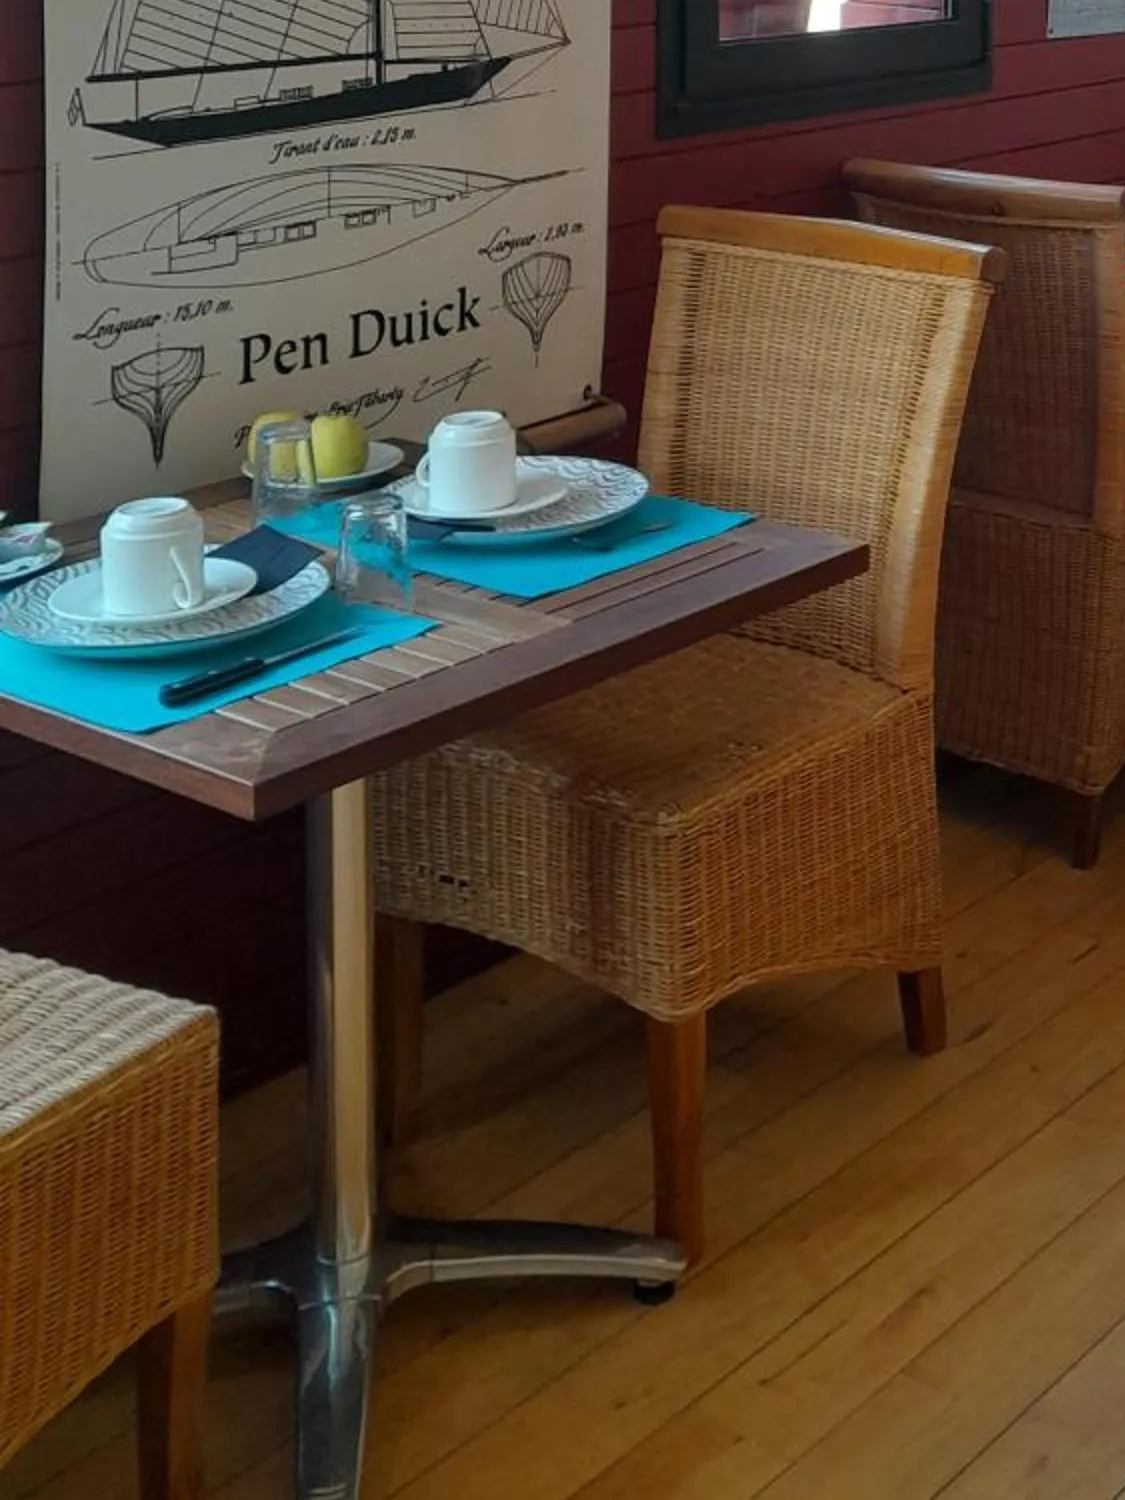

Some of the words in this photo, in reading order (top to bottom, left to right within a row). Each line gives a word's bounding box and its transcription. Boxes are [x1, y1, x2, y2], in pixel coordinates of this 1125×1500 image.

[268, 138, 321, 165] Tirant
[478, 226, 536, 262] Largeur
[72, 307, 162, 350] Longueur
[238, 332, 330, 386] Pen
[347, 286, 481, 360] Duick
